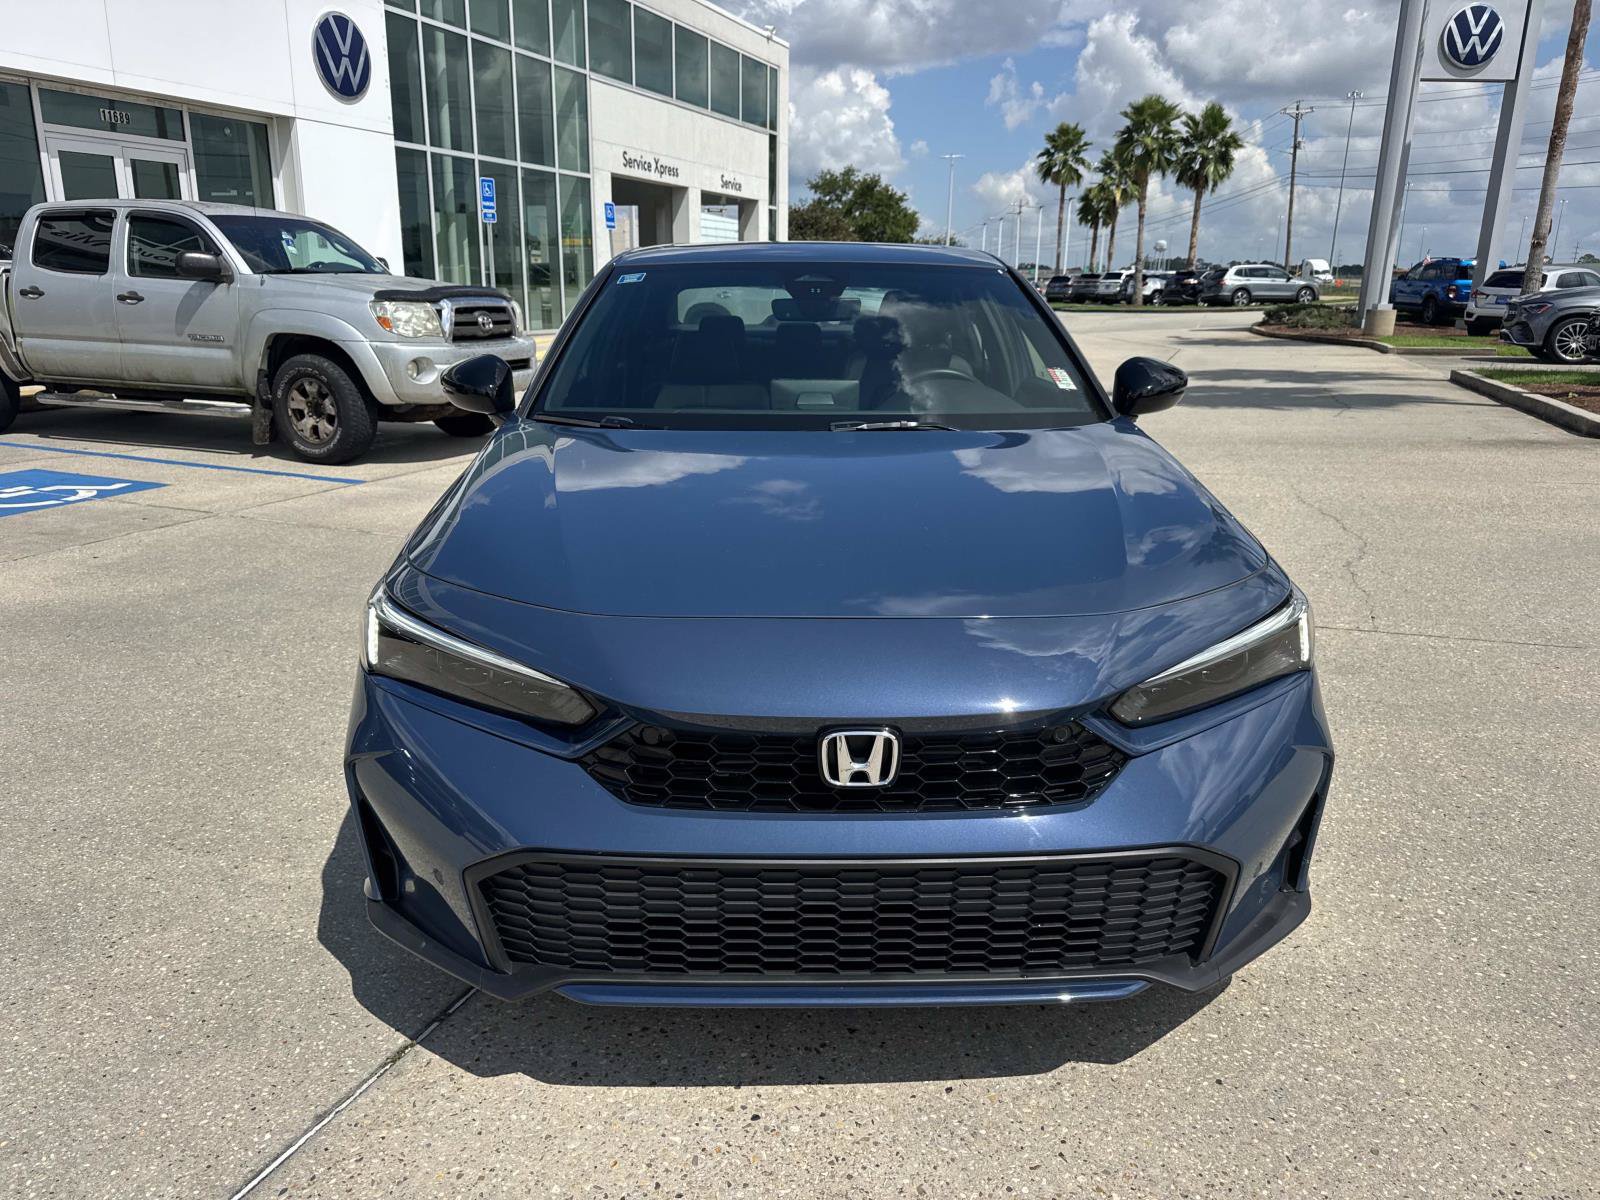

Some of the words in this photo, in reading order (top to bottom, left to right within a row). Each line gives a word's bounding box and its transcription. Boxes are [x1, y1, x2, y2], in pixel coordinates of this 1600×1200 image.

[101, 109, 130, 124] 11689
[622, 151, 652, 172] Service
[654, 157, 679, 178] Xpress
[721, 174, 742, 192] Service
